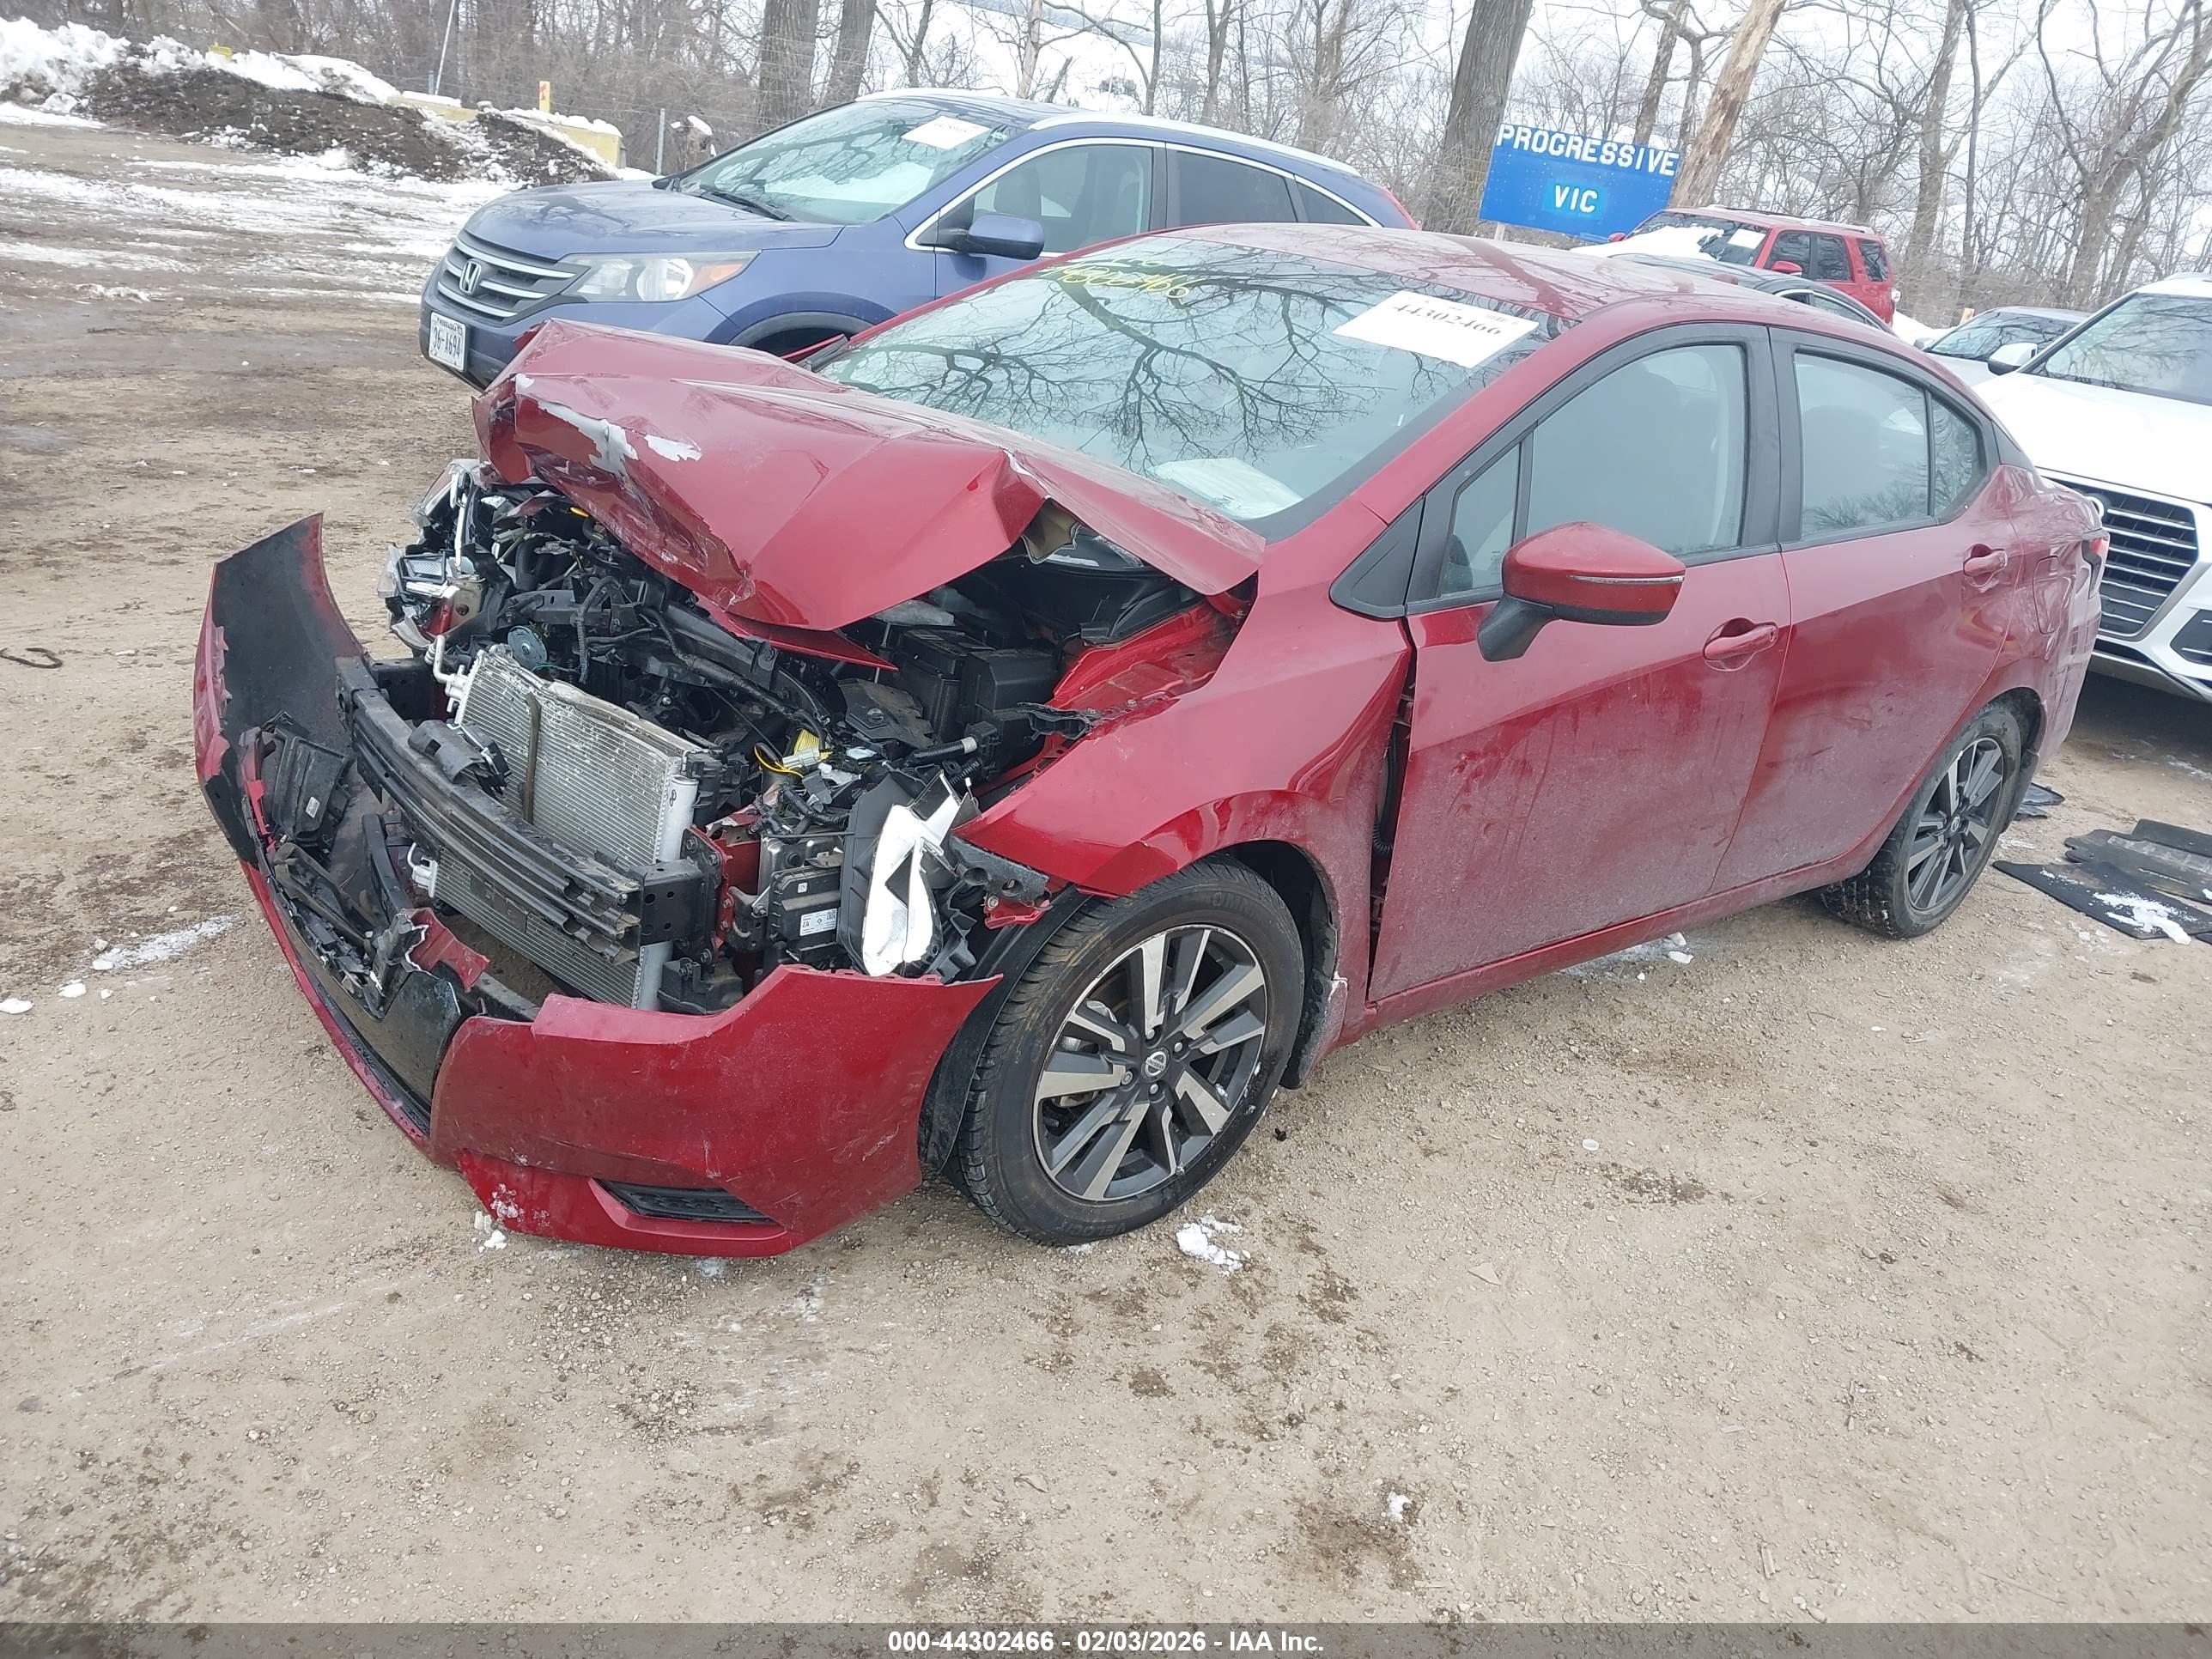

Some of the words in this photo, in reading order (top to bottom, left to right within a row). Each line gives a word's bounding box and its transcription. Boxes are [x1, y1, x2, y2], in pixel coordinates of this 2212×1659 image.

[1496, 124, 1680, 176] PROGRESSIVE
[1554, 185, 1598, 213] VIC
[1393, 303, 1502, 336] 44302466
